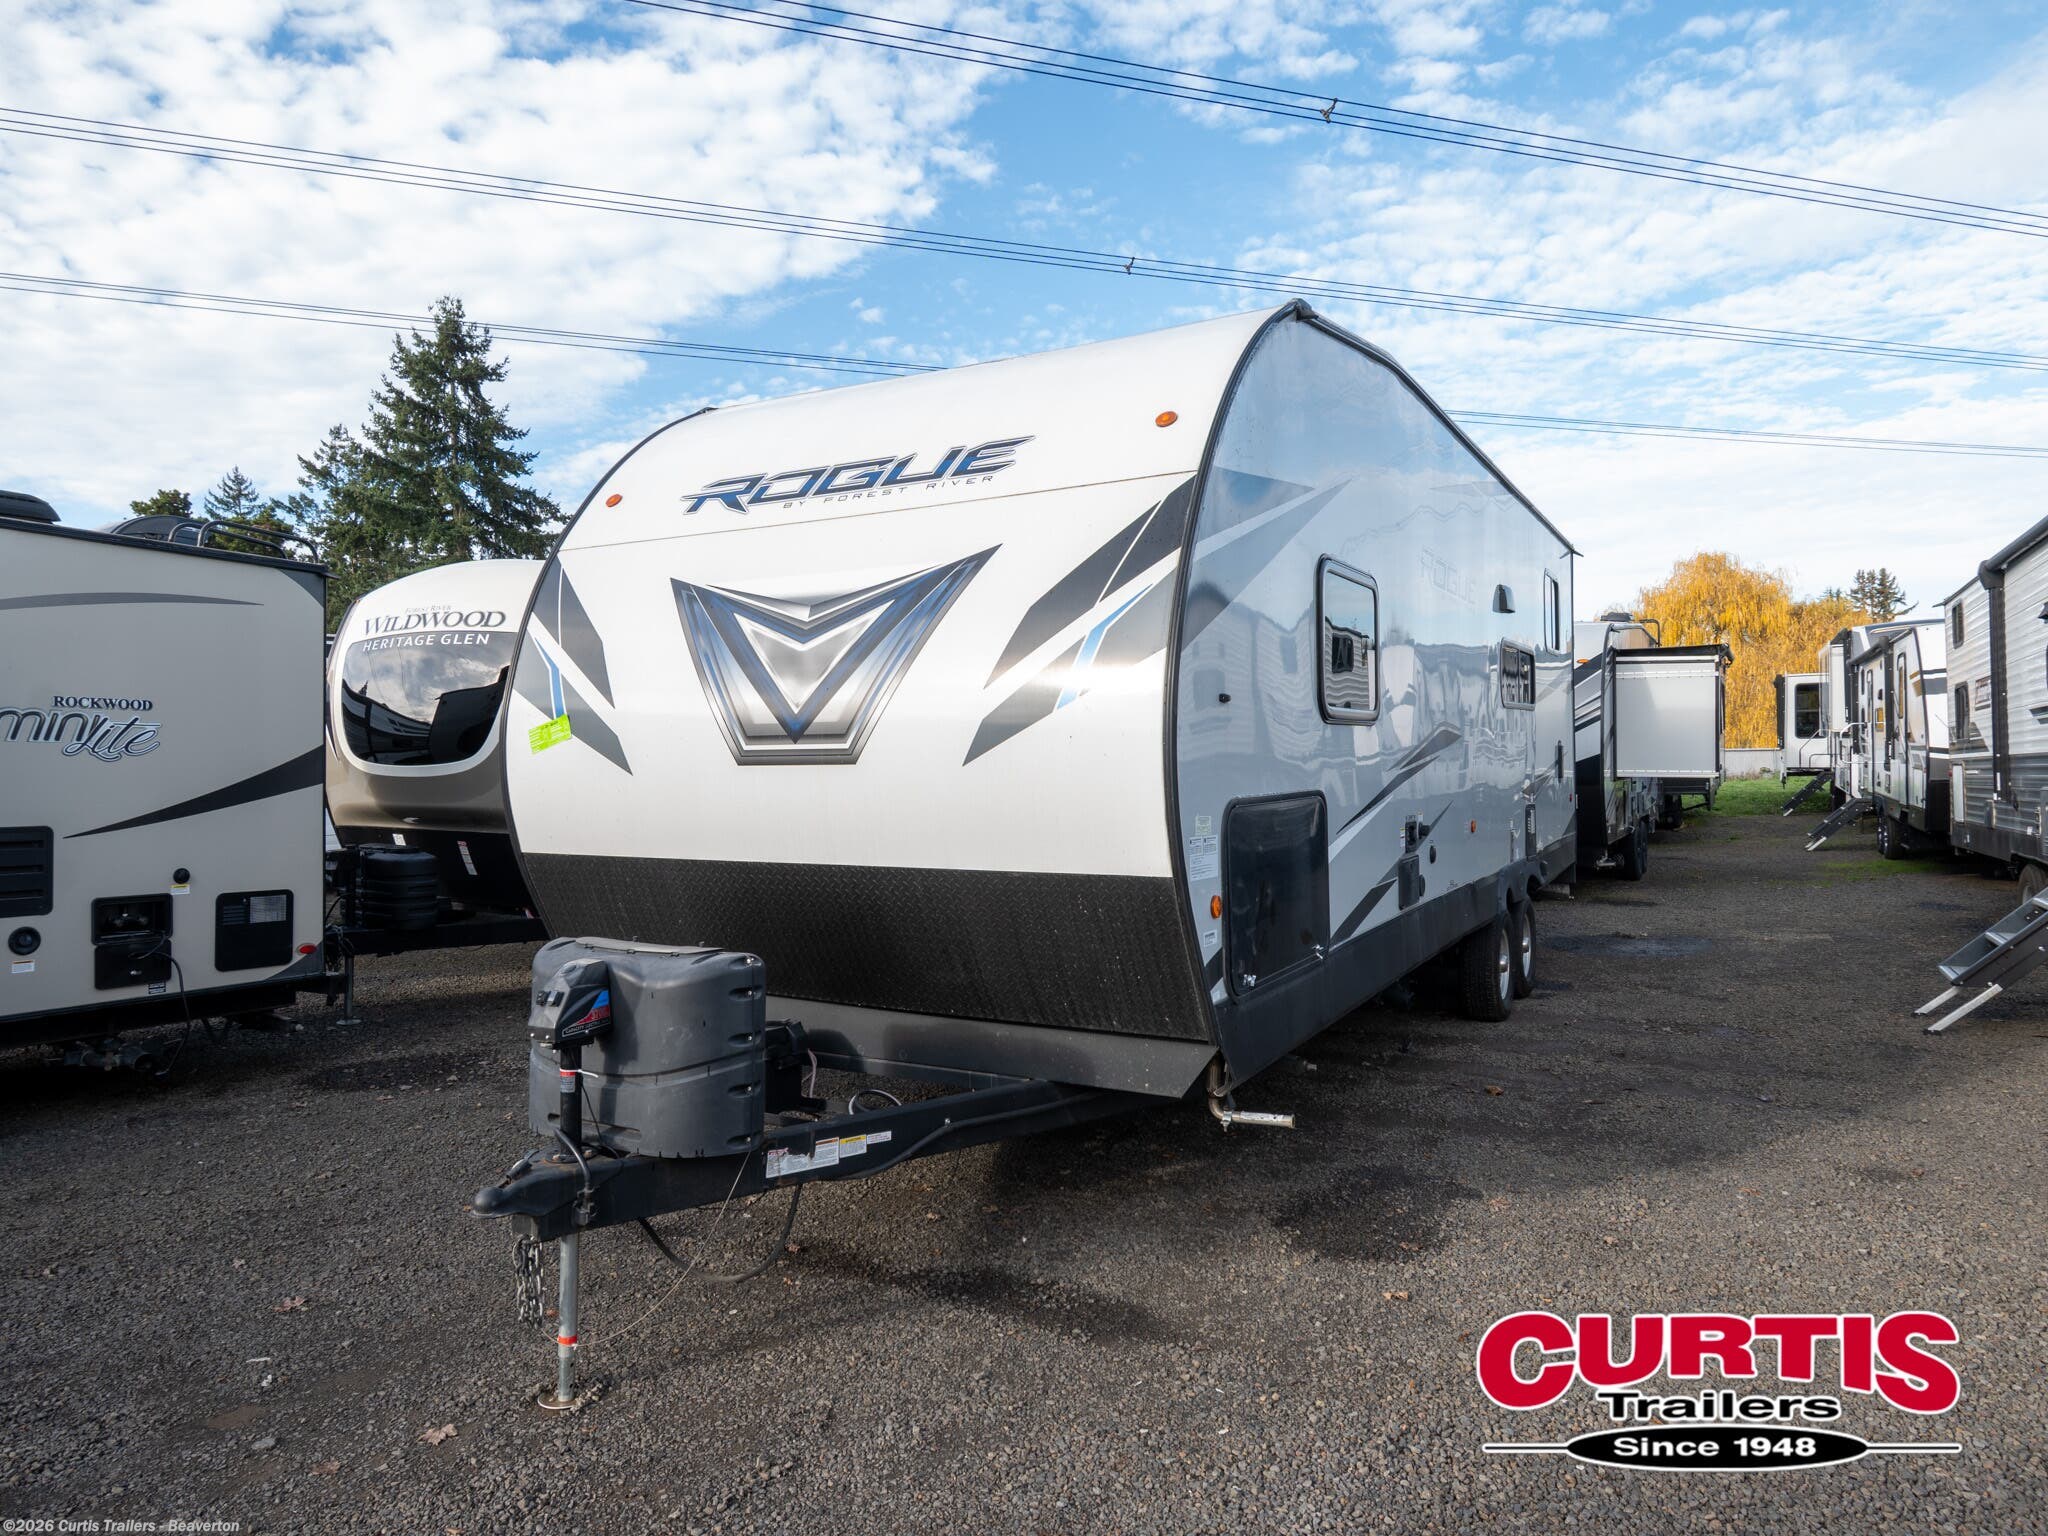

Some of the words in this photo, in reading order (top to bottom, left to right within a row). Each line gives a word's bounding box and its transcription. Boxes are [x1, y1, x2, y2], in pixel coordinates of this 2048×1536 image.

[680, 435, 1036, 515] ROGUE
[783, 500, 807, 510] BY
[823, 487, 906, 504] FOREST
[925, 475, 994, 489] RIVER
[364, 611, 506, 636] WILDWOOD
[362, 634, 435, 652] HERITAGE
[440, 633, 490, 645] GLEN
[53, 695, 153, 711] ROCKWOOD
